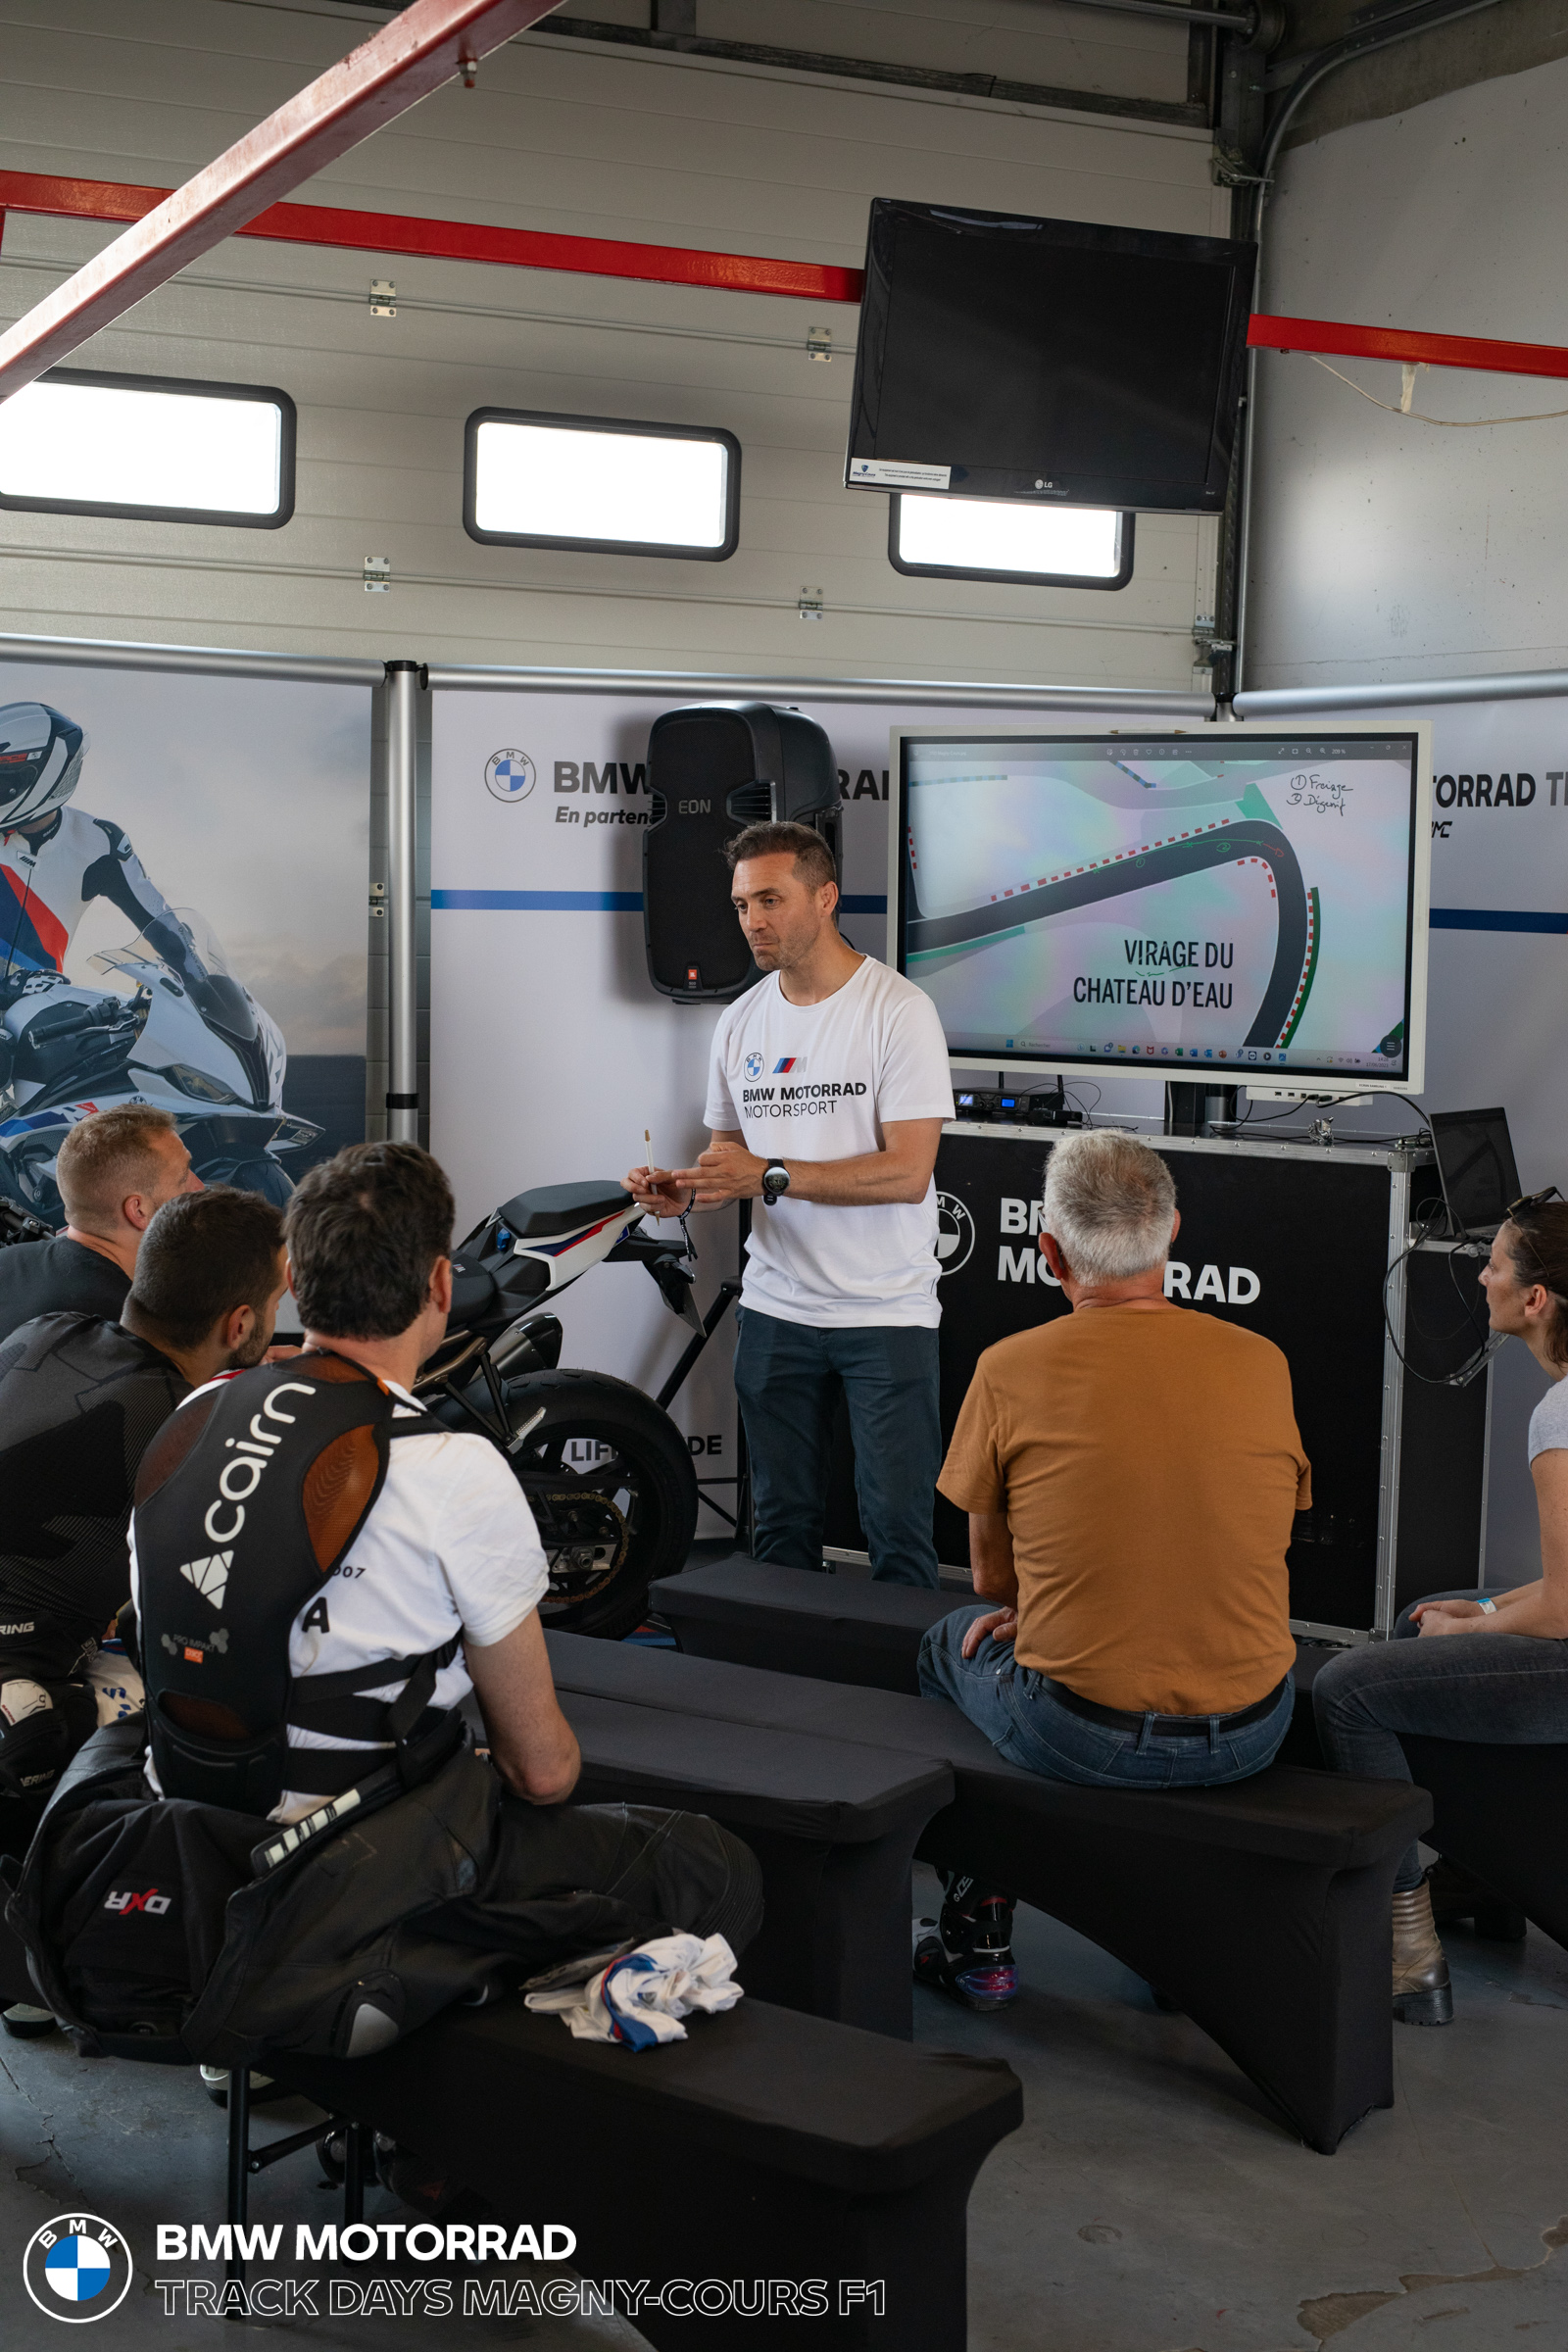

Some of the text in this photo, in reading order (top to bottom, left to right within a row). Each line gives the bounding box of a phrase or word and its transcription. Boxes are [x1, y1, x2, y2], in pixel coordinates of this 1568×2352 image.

[837, 769, 890, 801] RA
[1433, 771, 1568, 808] ORRAD T
[555, 806, 658, 827] En parten
[678, 799, 711, 814] EON
[1124, 940, 1234, 969] VIRAGE DU
[1073, 976, 1233, 1009] CHATEAU D'EAU
[743, 1082, 867, 1102] BMW MOTORRAD
[744, 1100, 837, 1119] MOTORSPORT
[204, 1382, 317, 1544] cairn
[570, 1441, 617, 1462] LIF
[104, 1887, 172, 1916] DXR
